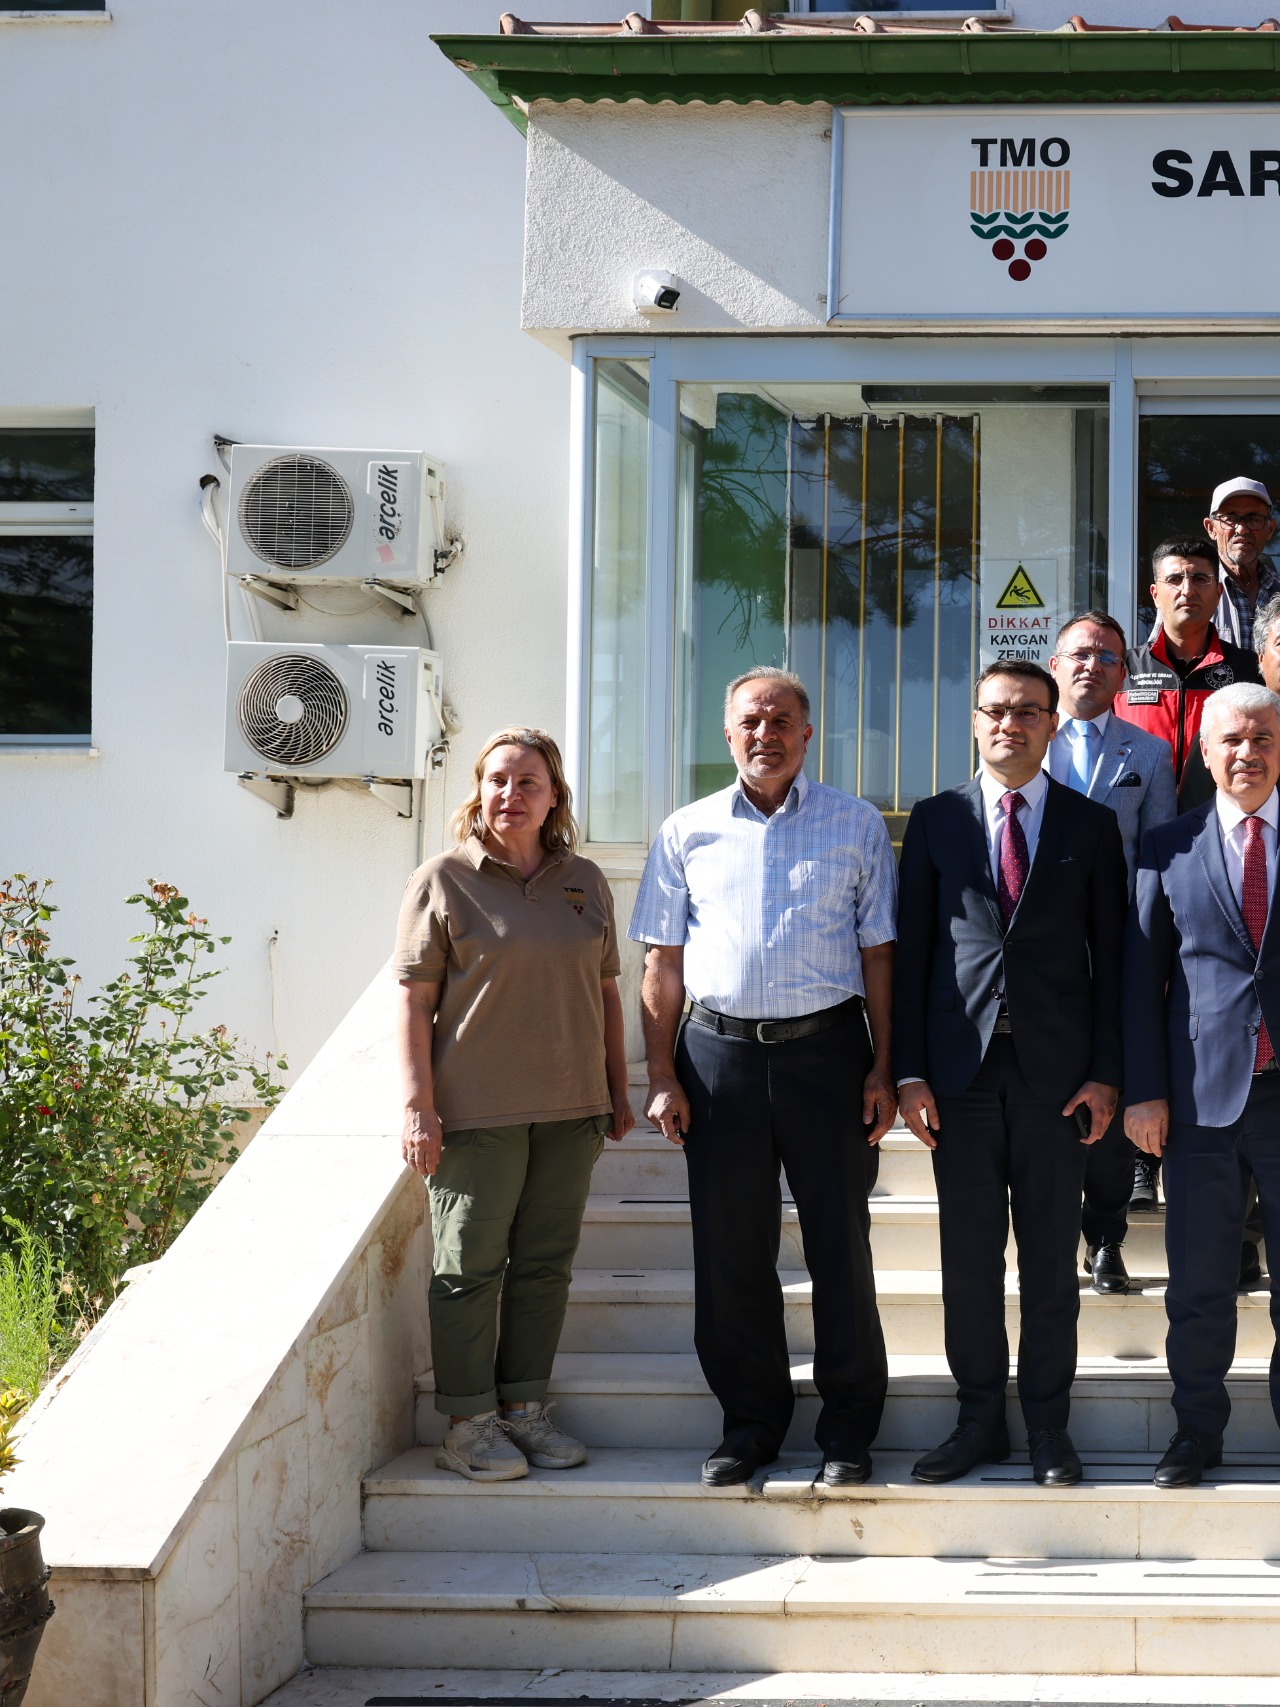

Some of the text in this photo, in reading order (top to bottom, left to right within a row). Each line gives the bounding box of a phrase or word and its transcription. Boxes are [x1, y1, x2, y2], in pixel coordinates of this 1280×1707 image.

[970, 137, 1071, 167] TMO
[377, 464, 401, 541] arçelik
[988, 615, 1051, 629] DİKKAT
[990, 634, 1048, 646] KAYGAN
[997, 646, 1040, 661] ZEMİN
[376, 660, 399, 736] arçelik
[562, 886, 584, 894] TMO
